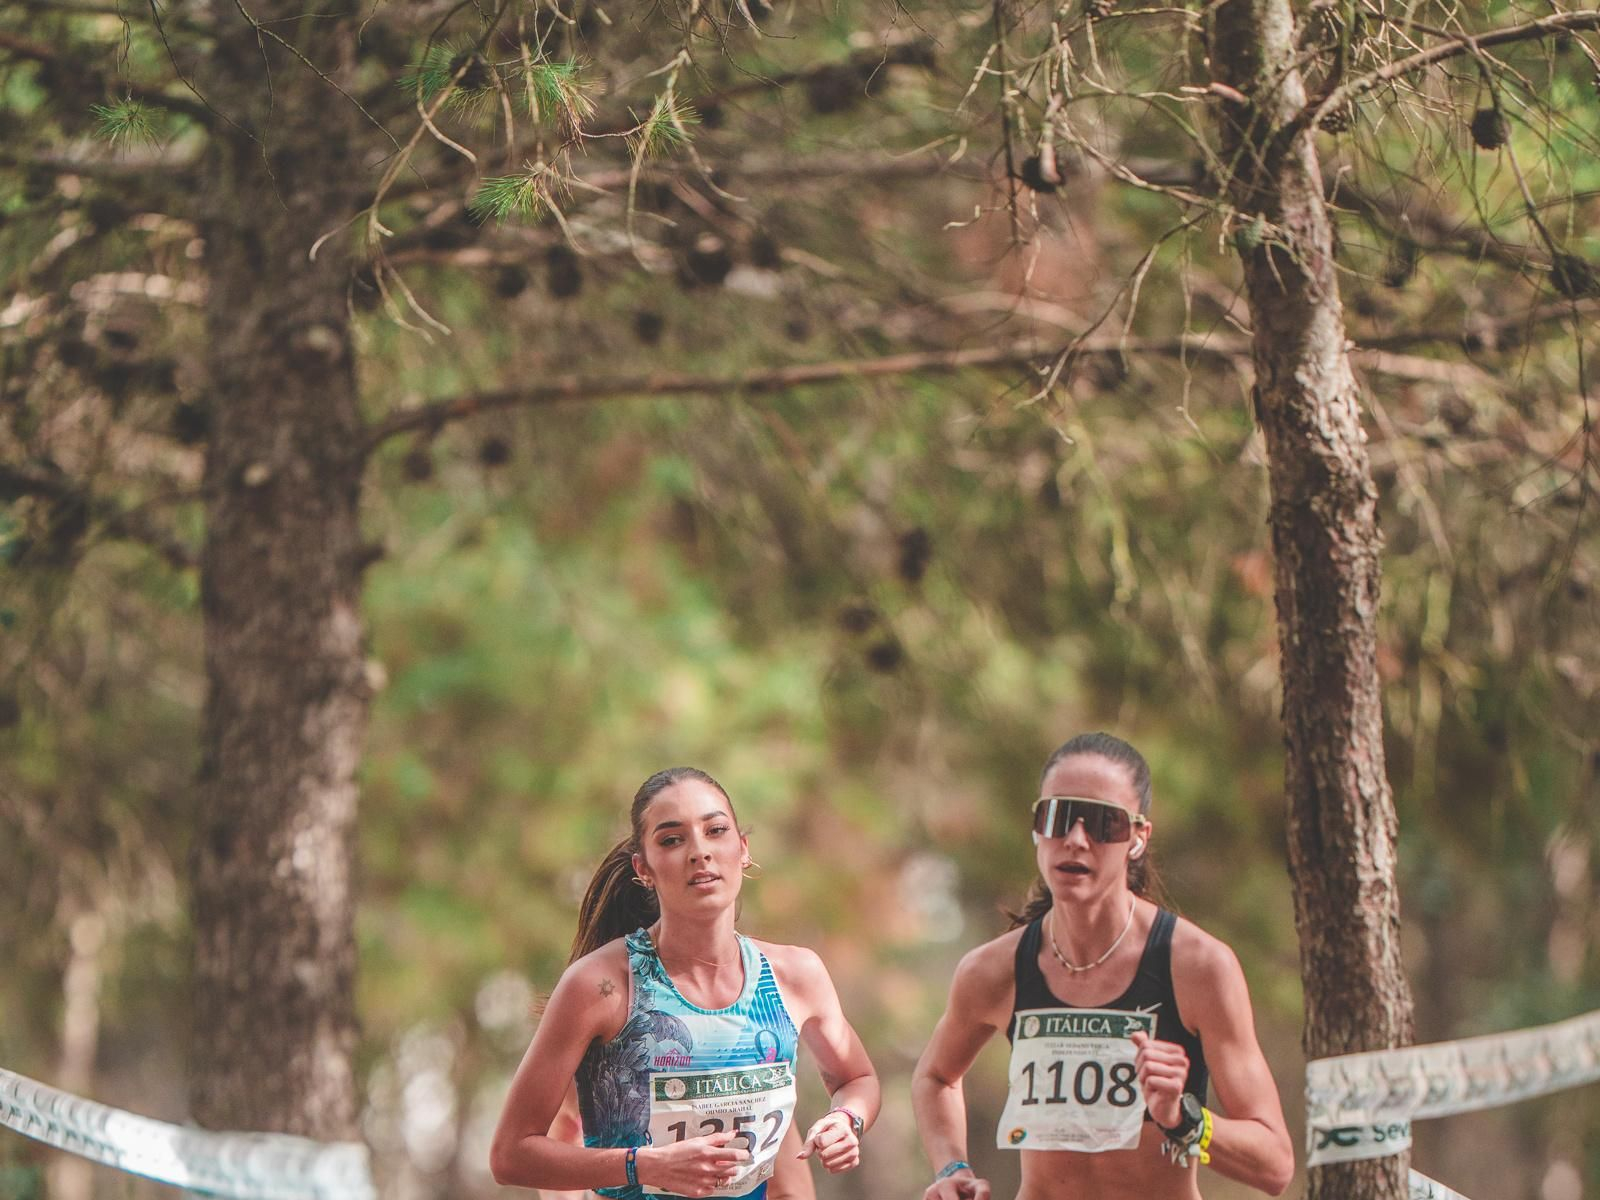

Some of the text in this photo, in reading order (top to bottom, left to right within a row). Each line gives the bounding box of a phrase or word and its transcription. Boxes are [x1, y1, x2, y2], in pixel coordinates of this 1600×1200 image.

[1045, 1014, 1112, 1034] ITÁLICA
[653, 1055, 691, 1067] HORIZON
[695, 1074, 762, 1095] ITÁLICA
[1021, 1061, 1138, 1107] 1108
